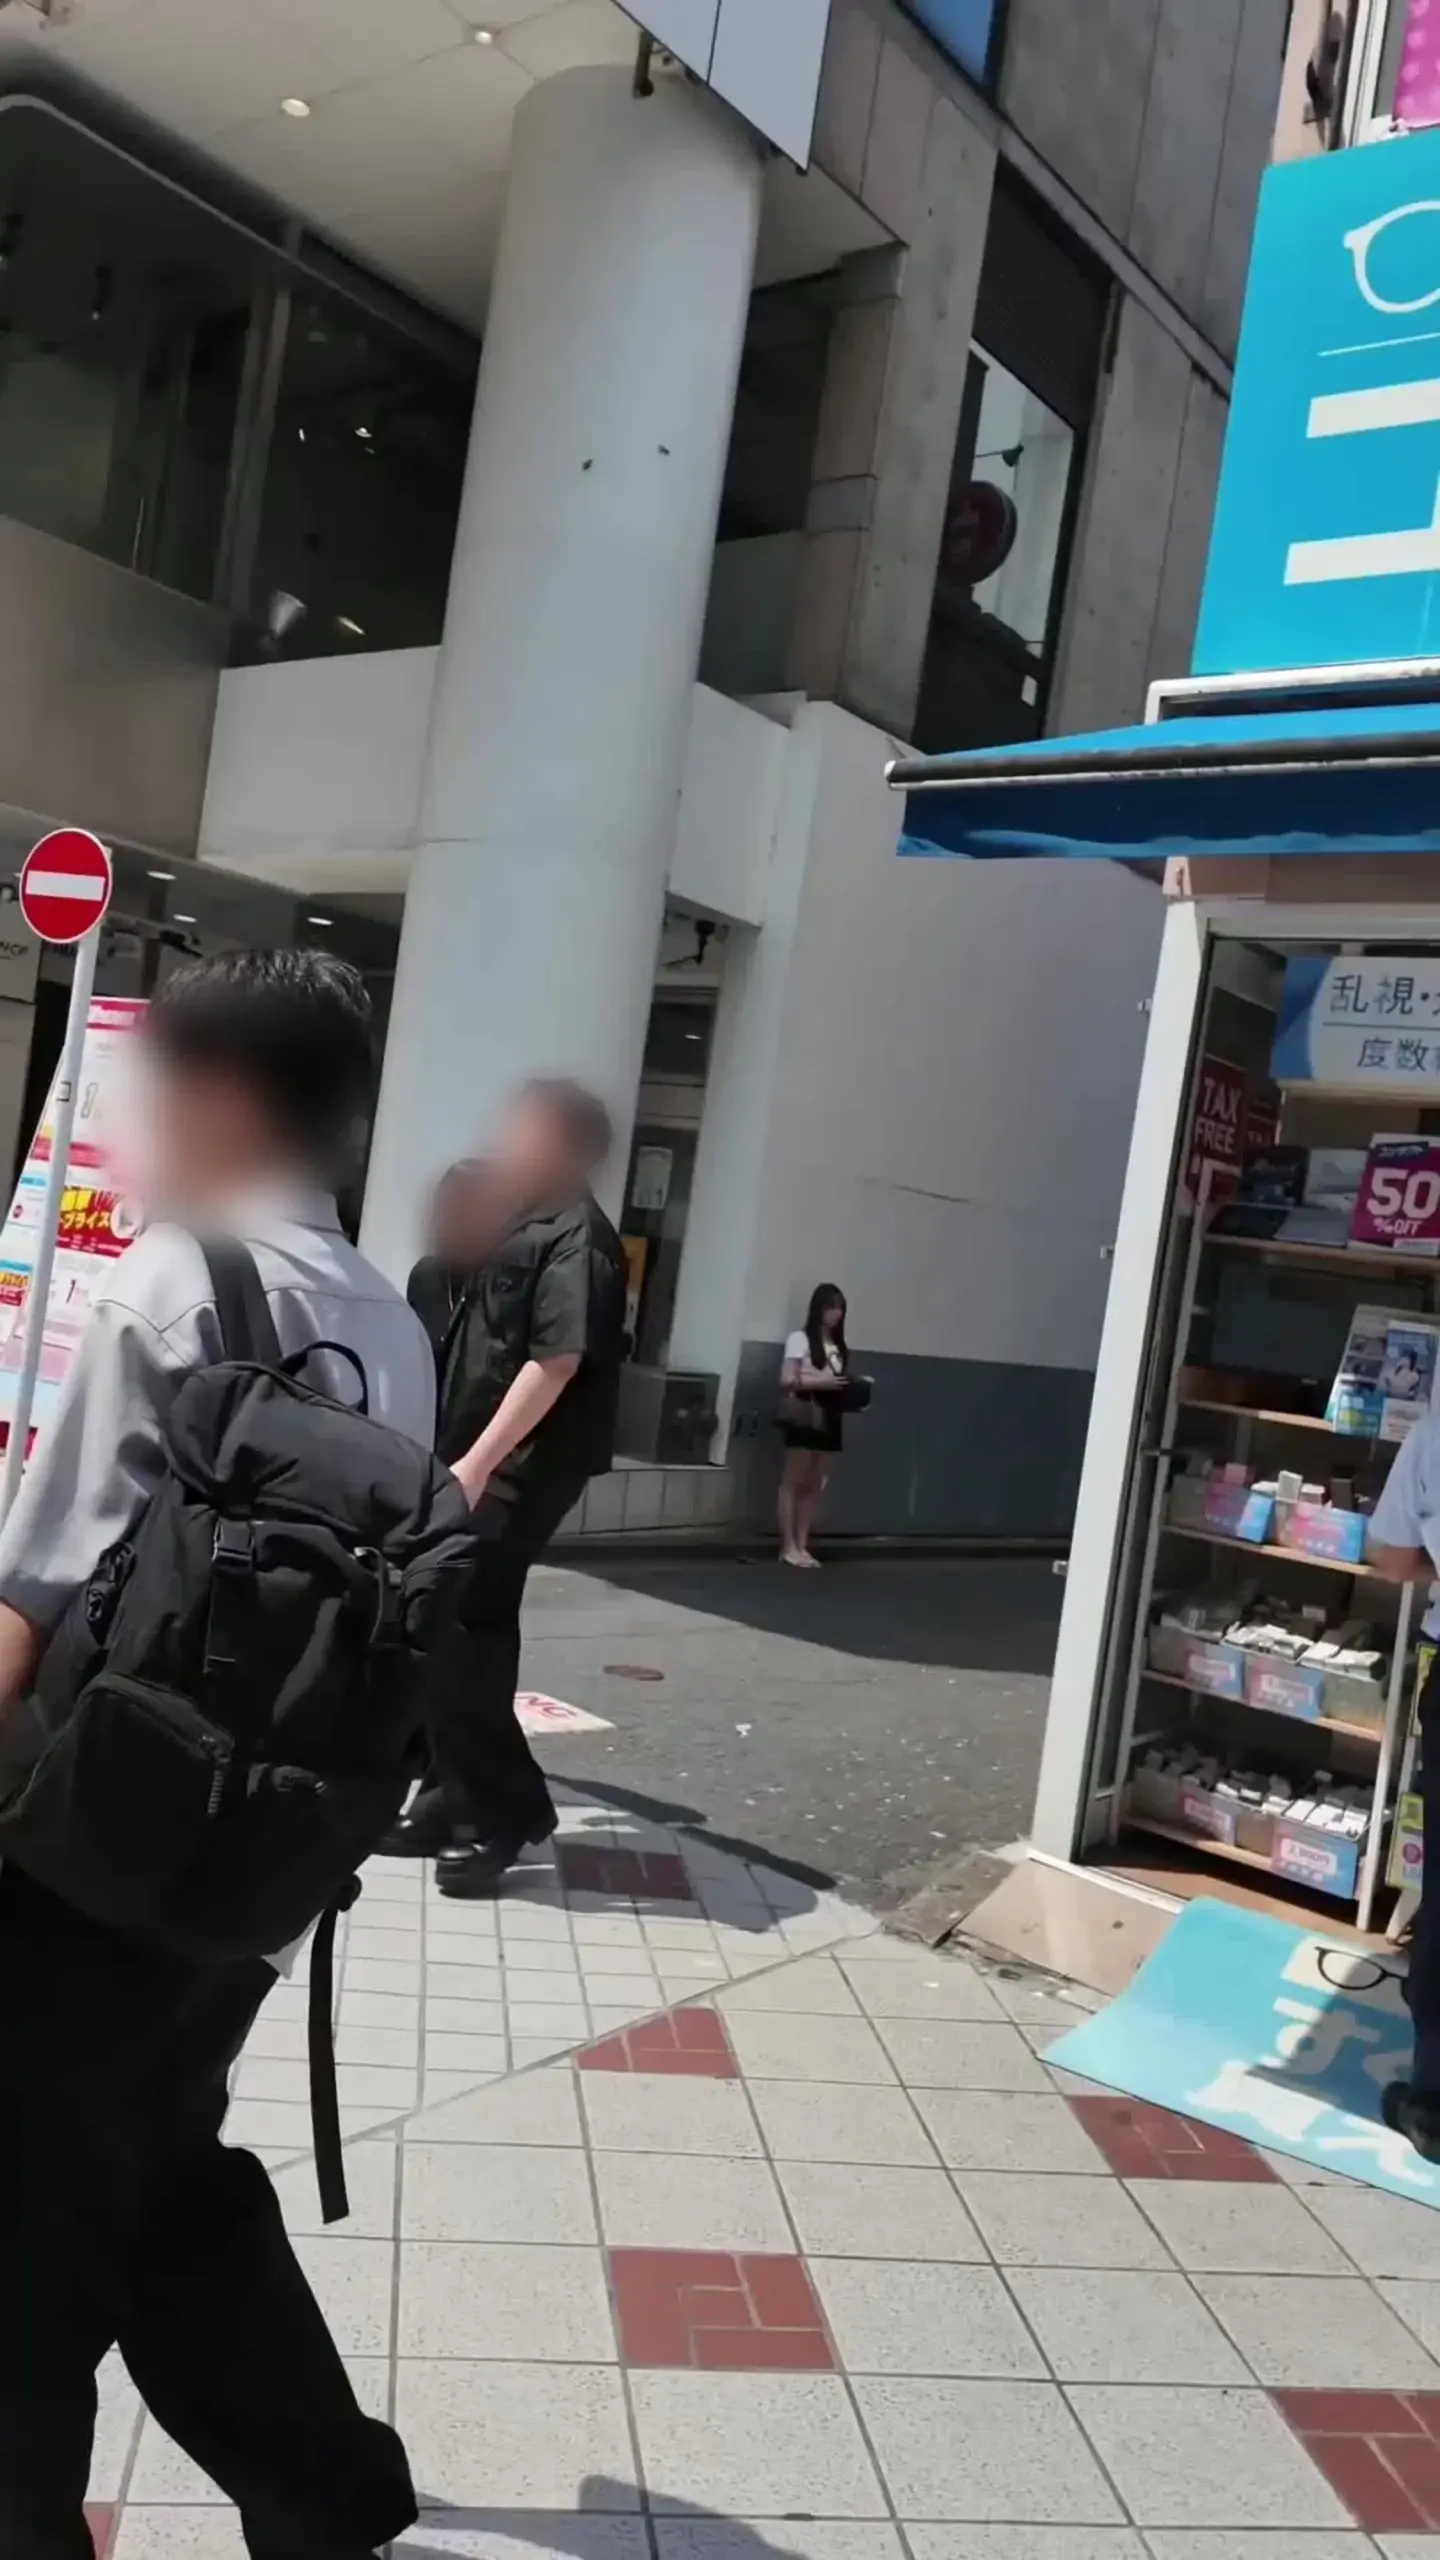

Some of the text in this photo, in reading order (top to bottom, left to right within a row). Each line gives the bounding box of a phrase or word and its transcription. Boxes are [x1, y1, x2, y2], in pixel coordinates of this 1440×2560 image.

[1330, 973, 1440, 1016] 乱視・
[1357, 1036, 1440, 1076] 度数
[1203, 1076, 1242, 1124] TAX
[1195, 1116, 1236, 1153] FREE
[1366, 1167, 1440, 1219] 50
[1373, 1217, 1422, 1236] %OFF
